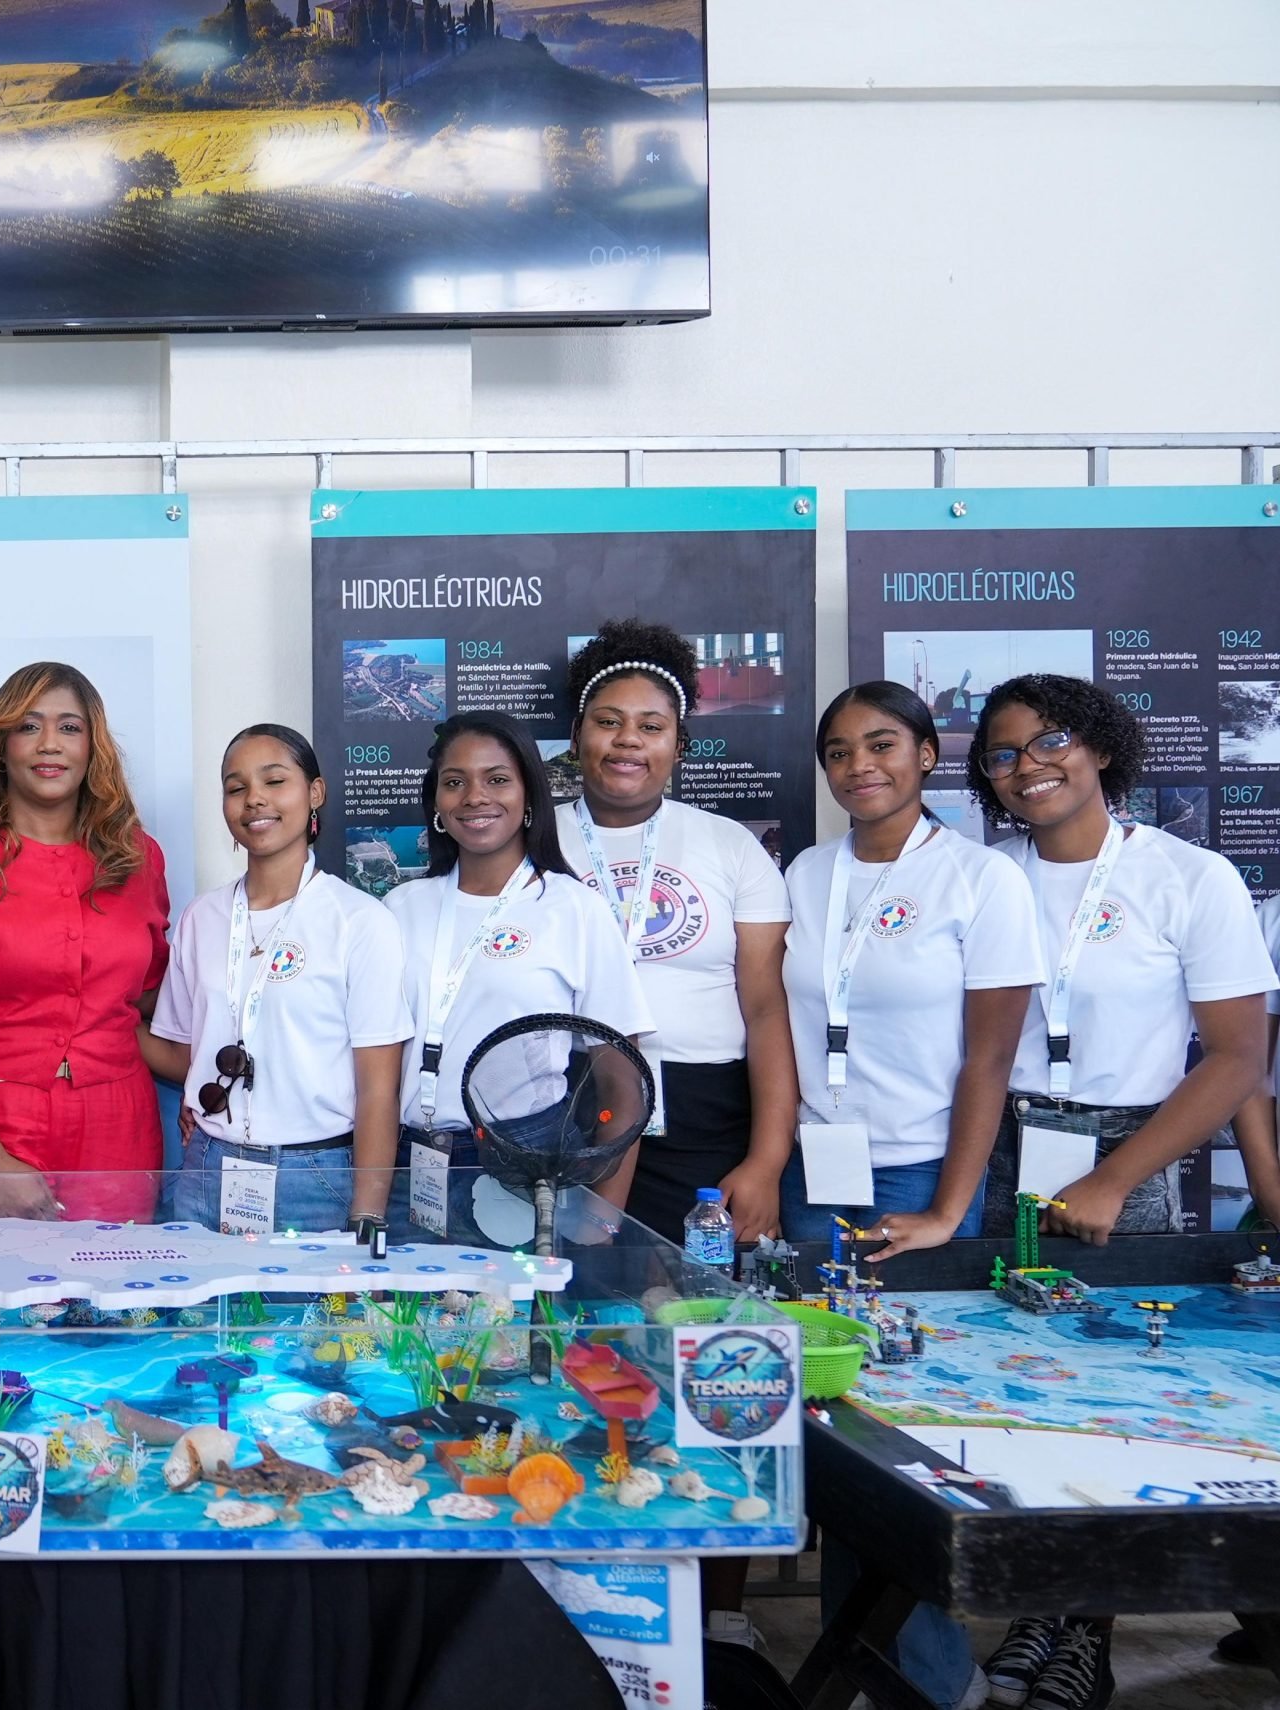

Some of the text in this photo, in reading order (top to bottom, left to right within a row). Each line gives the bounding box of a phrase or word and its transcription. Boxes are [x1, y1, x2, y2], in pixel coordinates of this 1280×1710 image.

[590, 245, 661, 267] 00:31
[342, 574, 542, 609] HIDROELÉCTRICAS
[883, 568, 1075, 602] HIDROELÉCTRICAS
[1106, 630, 1150, 648] 1926
[1219, 630, 1262, 648] 1942
[458, 641, 503, 659] 1984
[1219, 653, 1263, 661] Inauguración
[524, 663, 551, 671] Hatillo,
[1117, 663, 1145, 671] madera,
[468, 673, 499, 681] Sánchez
[501, 673, 532, 681] Ramírez.
[1106, 673, 1141, 681] Maguana.
[458, 684, 483, 692] (Hatillo
[489, 685, 494, 693] y
[458, 703, 494, 712] capacidad
[345, 745, 390, 763] 1986
[716, 762, 754, 770] Aguacate.
[1220, 786, 1264, 804] 1967
[641, 914, 702, 956] DE PAULA
[414, 1194, 443, 1211] EXPOSITOR
[226, 1208, 269, 1222] EXPOSITOR
[689, 1380, 787, 1395] TECNOMAR
[1194, 1480, 1278, 1490] FIRST
[588, 1623, 663, 1640] Mar Caribe
[599, 1655, 651, 1675] Mayor
[621, 1672, 650, 1689] 324
[621, 1686, 650, 1700] 713
